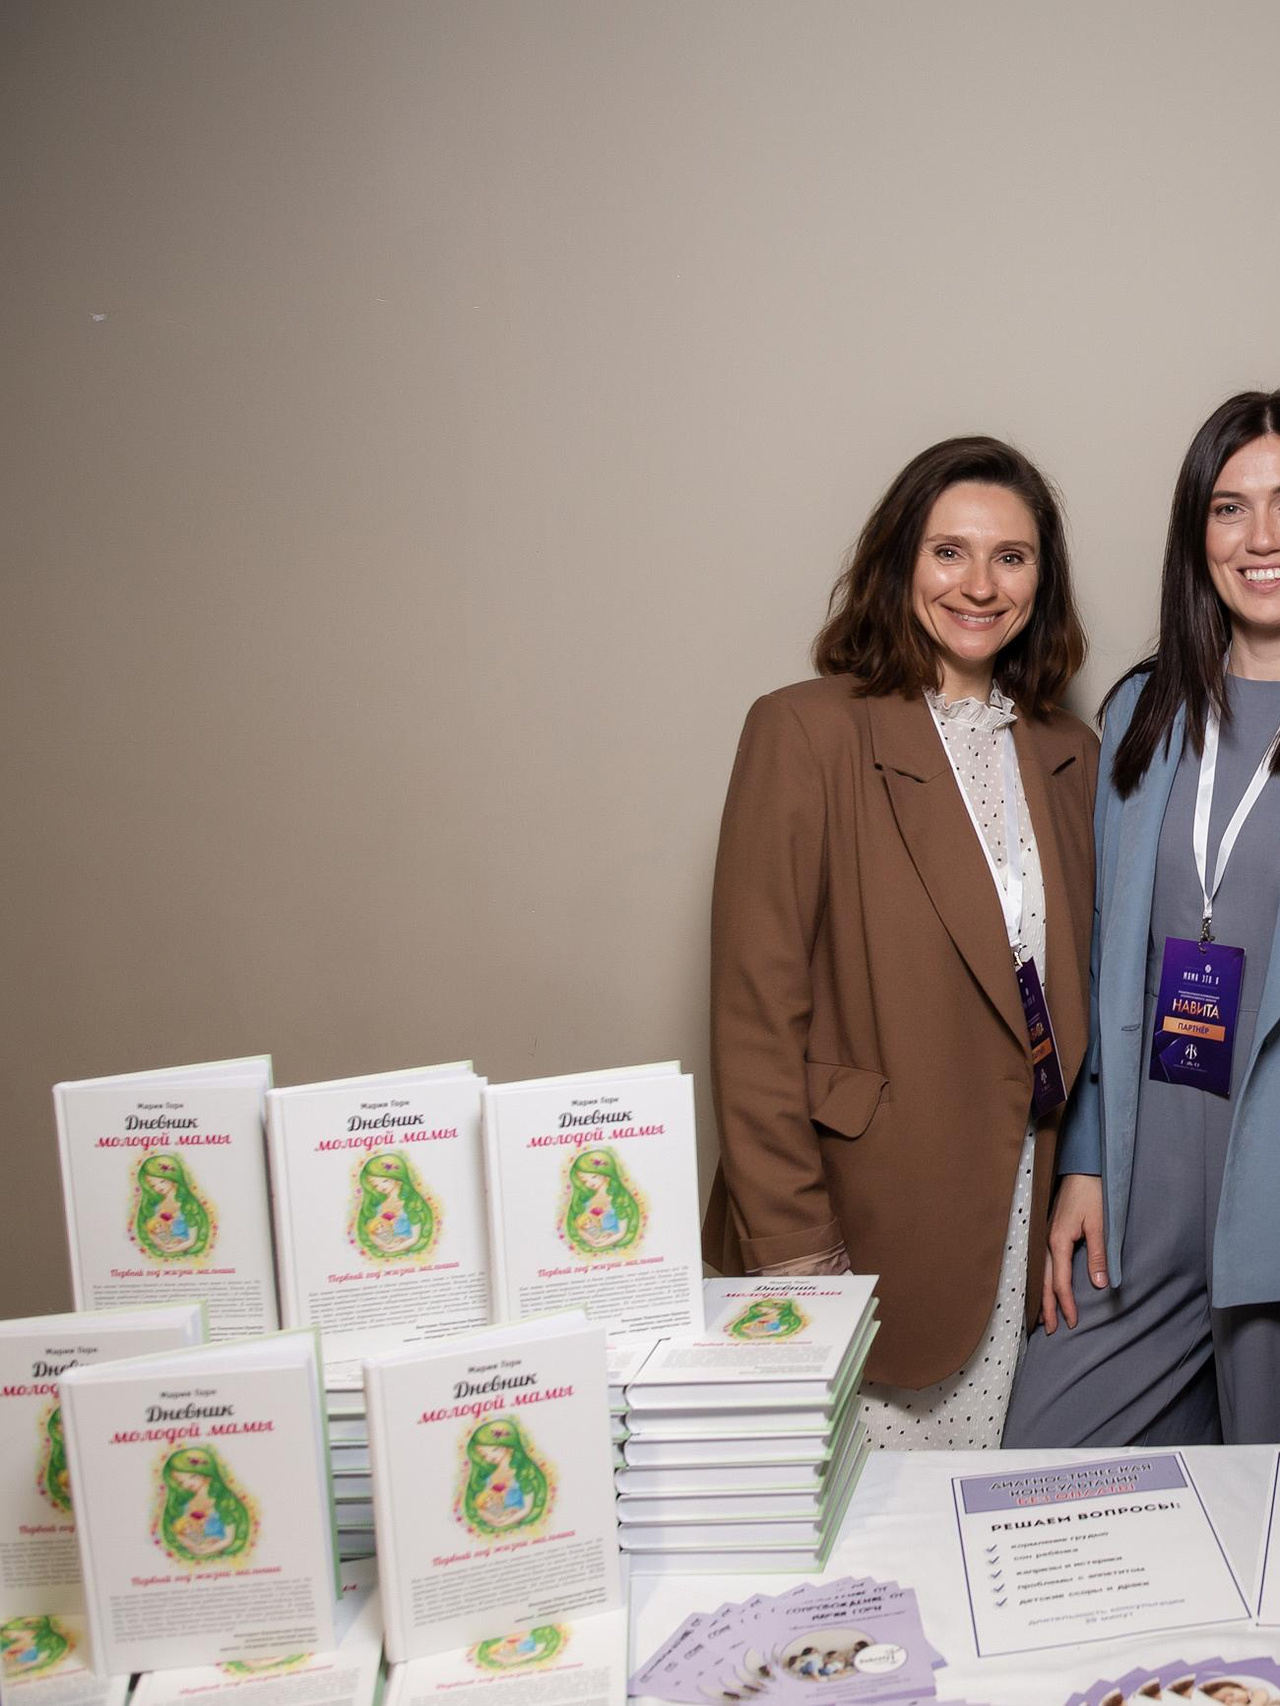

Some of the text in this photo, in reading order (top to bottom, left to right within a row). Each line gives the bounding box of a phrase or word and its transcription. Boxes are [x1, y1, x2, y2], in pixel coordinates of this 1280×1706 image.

[1172, 998, 1219, 1019] НАВИТА
[125, 1114, 198, 1130] Дневник
[347, 1113, 424, 1132] Дневник
[558, 1109, 633, 1129] Дневник
[95, 1132, 232, 1150] молодой мамы
[314, 1127, 458, 1151] молодой мамы
[526, 1124, 666, 1148] молодой мамы
[721, 1290, 844, 1300] молодой мамы
[754, 1284, 818, 1292] Дневник
[453, 1372, 538, 1399] Дневник
[147, 1403, 235, 1423] Дневник
[417, 1385, 575, 1424] молодой мамы
[109, 1420, 275, 1444] молодой мамы
[990, 1464, 1151, 1490] ДИАГНОСТИЧЕСКАЯ
[1010, 1475, 1139, 1497] КОНСУЛЬТАЦИЯ
[991, 1501, 1181, 1532] РЕШАЕМ ВОПРОСЫ:
